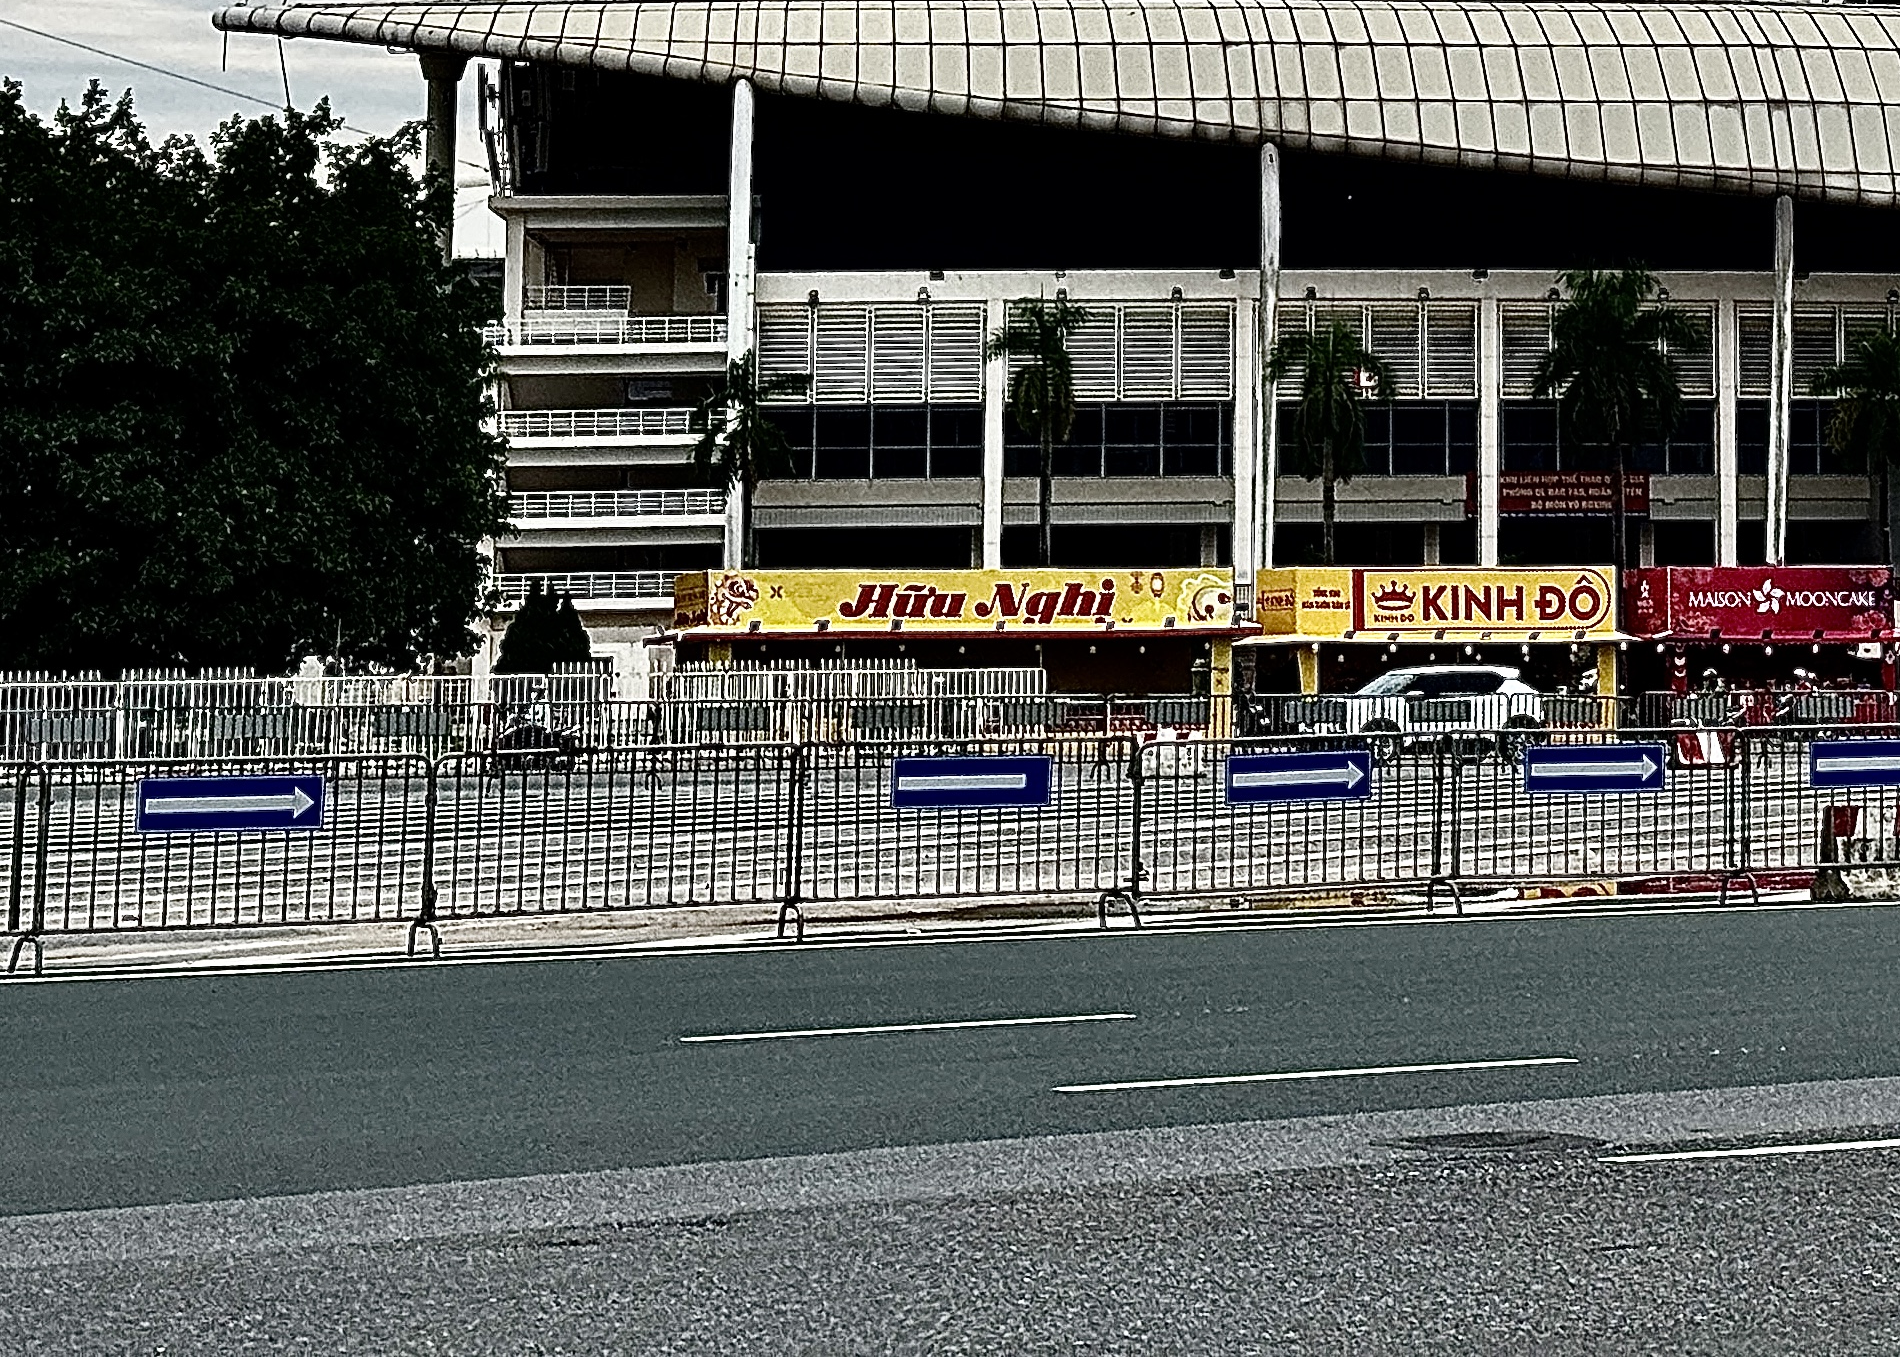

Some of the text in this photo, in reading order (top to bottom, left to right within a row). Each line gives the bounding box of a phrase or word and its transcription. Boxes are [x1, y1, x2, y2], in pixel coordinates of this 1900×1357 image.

[839, 579, 1115, 624] Hữu Nghị
[1422, 574, 1601, 621] KINH ĐÔ
[1689, 590, 1876, 608] MAISON MOONCAKE
